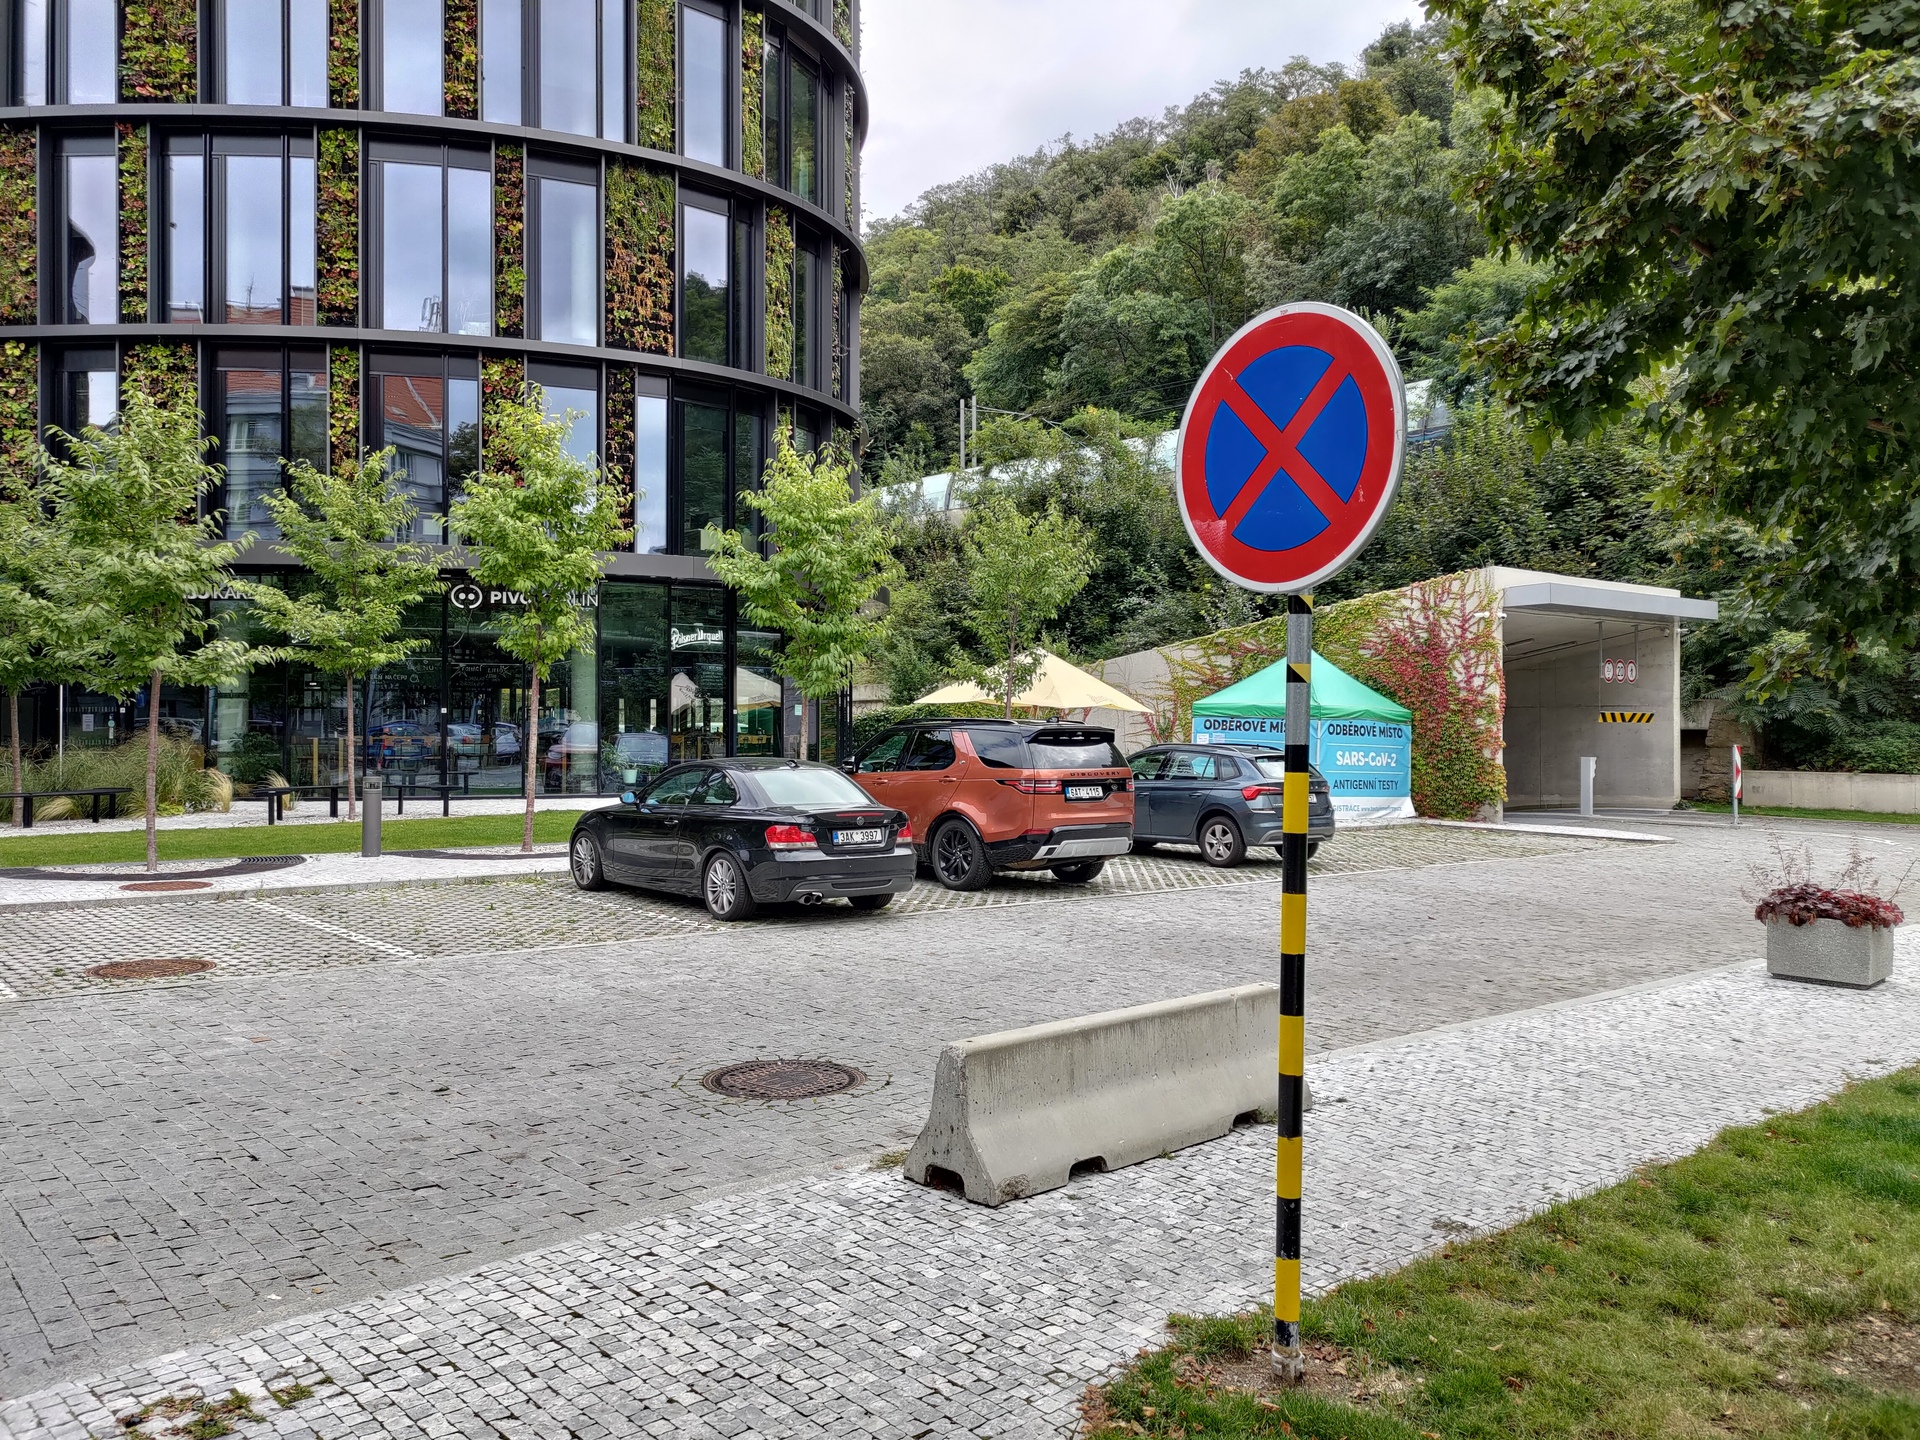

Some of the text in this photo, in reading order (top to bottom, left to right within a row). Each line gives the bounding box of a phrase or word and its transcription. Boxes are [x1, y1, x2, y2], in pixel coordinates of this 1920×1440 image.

[671, 627, 724, 651] Pilsner Urquell
[1203, 717, 1267, 732] ODBĚROVÉ
[1327, 721, 1403, 739] ODBĚROVÉ MÍSTO
[1336, 750, 1397, 767] SARS-CoV-2
[1333, 777, 1399, 790] ANTIGENNÍ TESTY
[1332, 804, 1360, 812] GISTRACE
[840, 830, 878, 841] 3AK 3997
